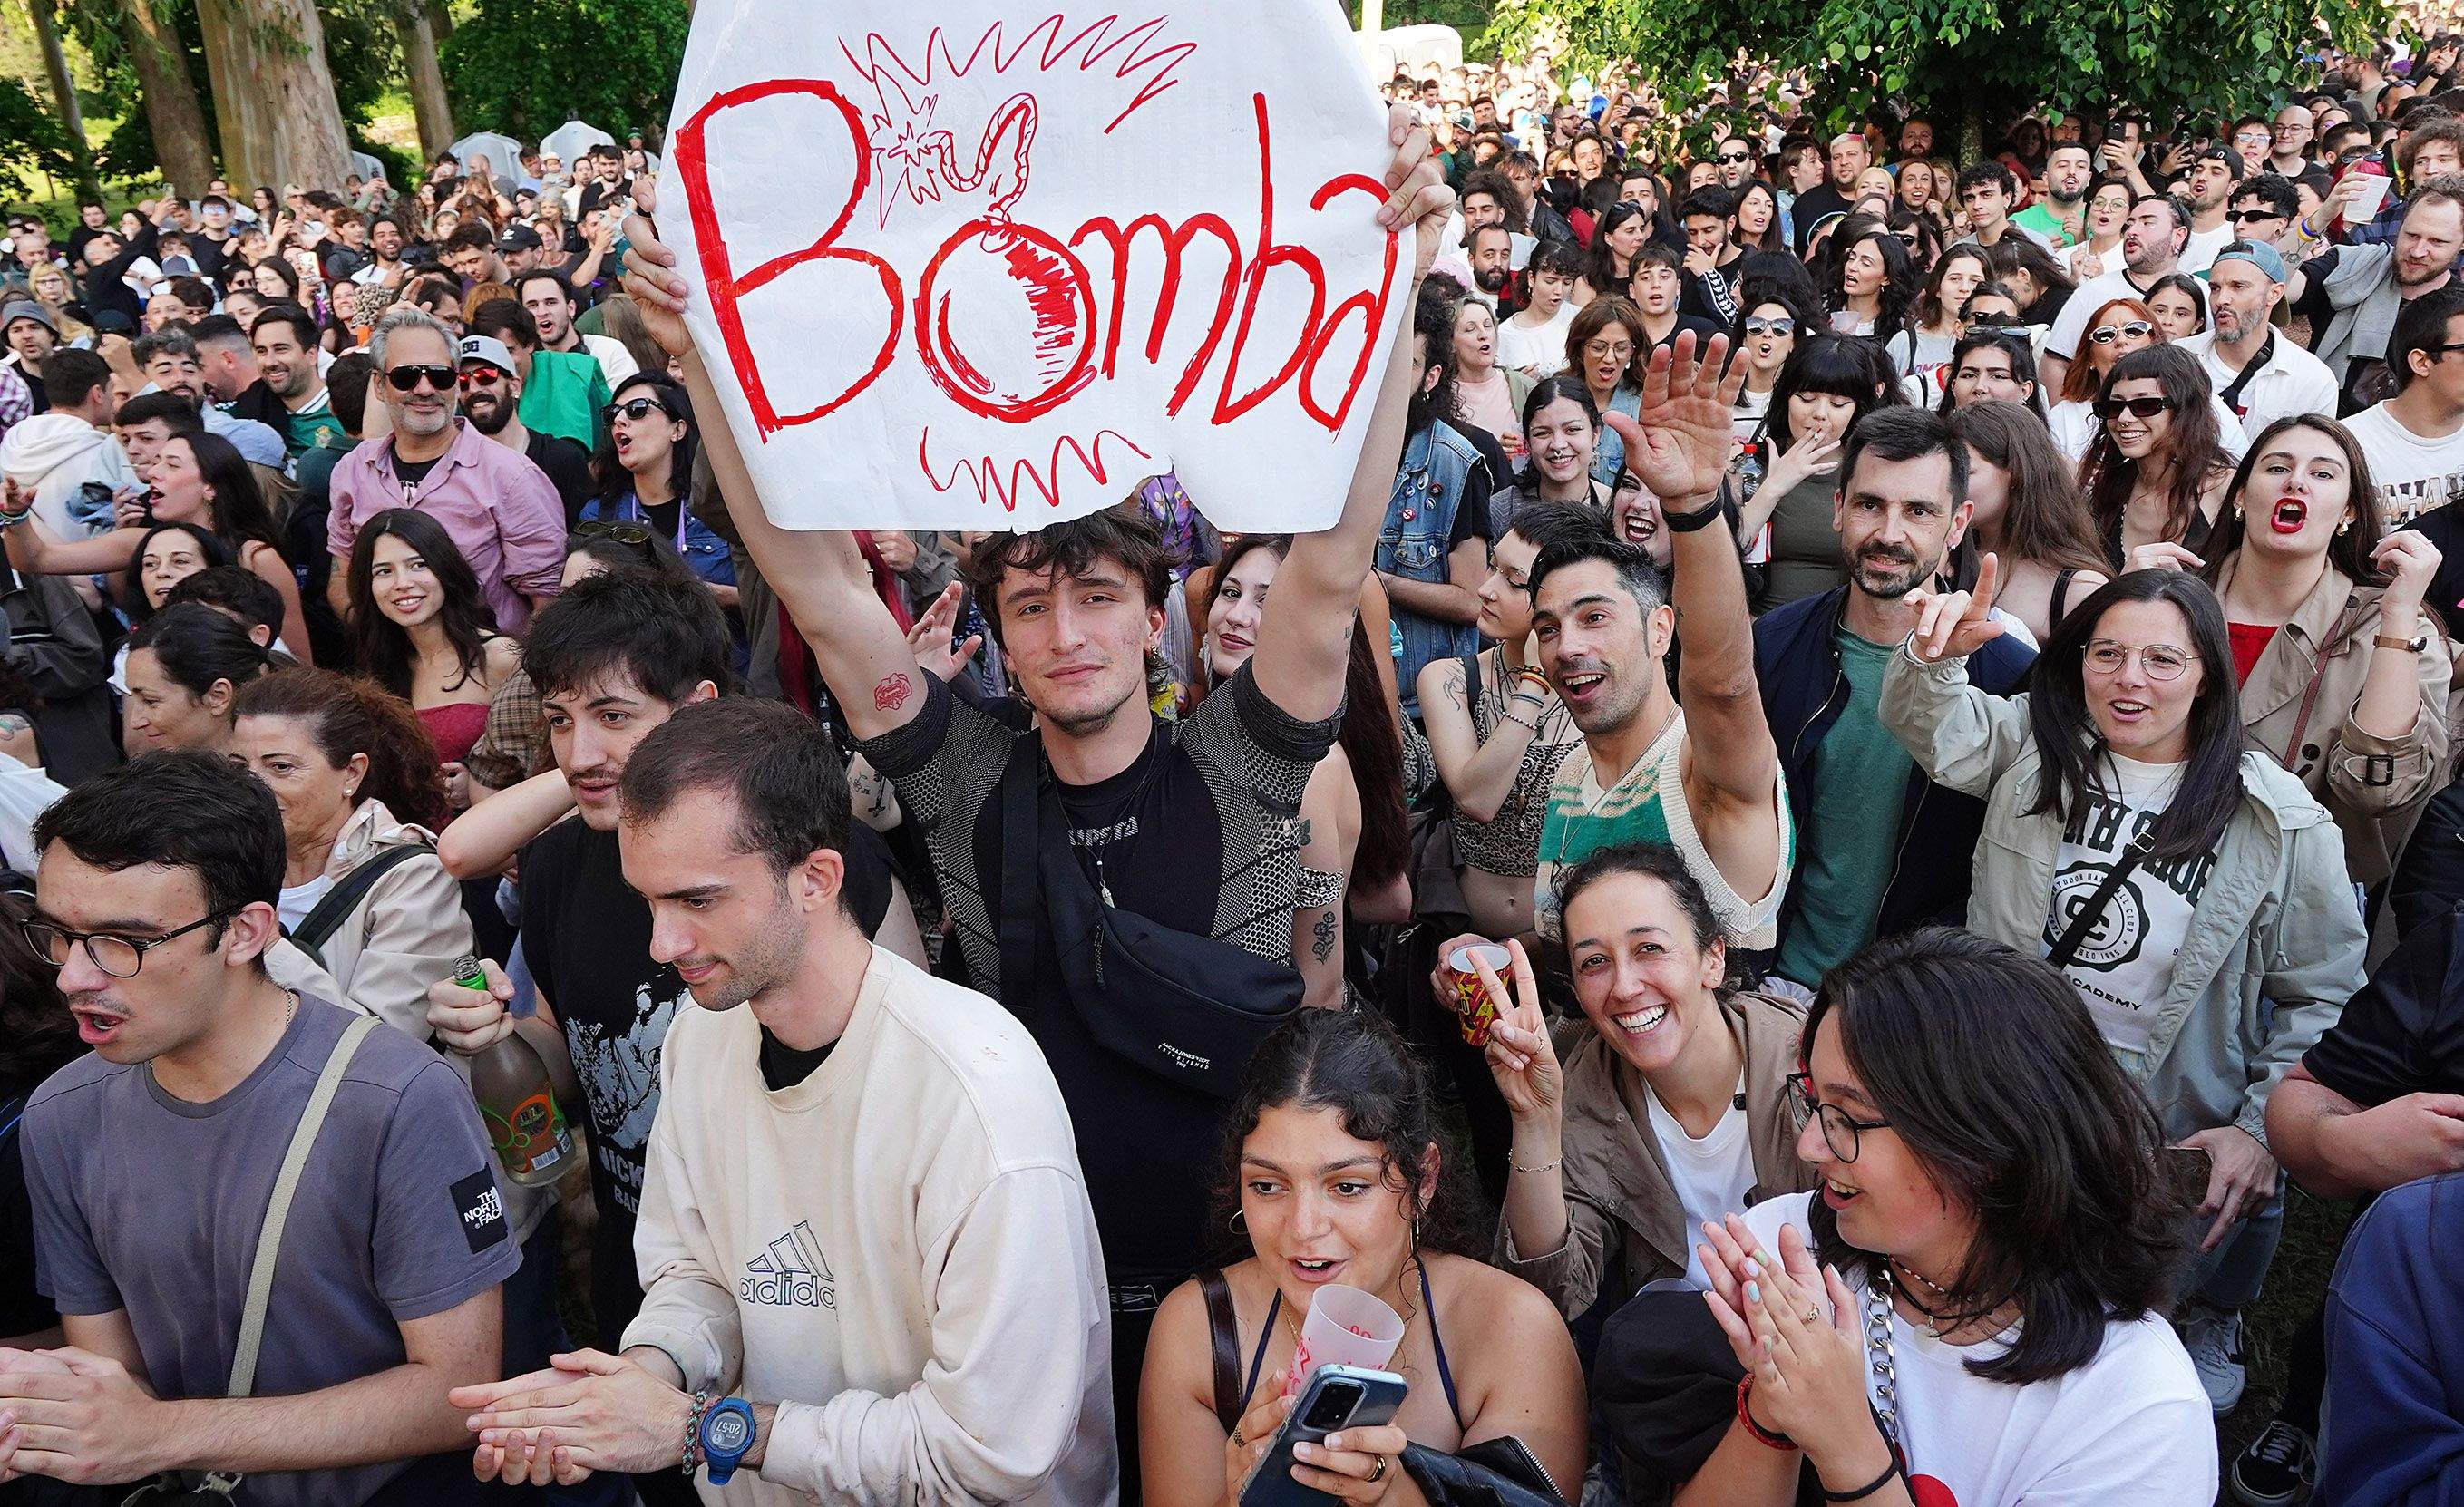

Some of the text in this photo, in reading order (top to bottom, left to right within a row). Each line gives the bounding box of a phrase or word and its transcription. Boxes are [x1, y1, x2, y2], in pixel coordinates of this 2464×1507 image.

[675, 78, 1399, 445] Bomba
[476, 1186, 501, 1204] TH
[478, 1208, 502, 1227] FAC
[738, 1271, 836, 1309] adida
[716, 1421, 742, 1435] 20:57
